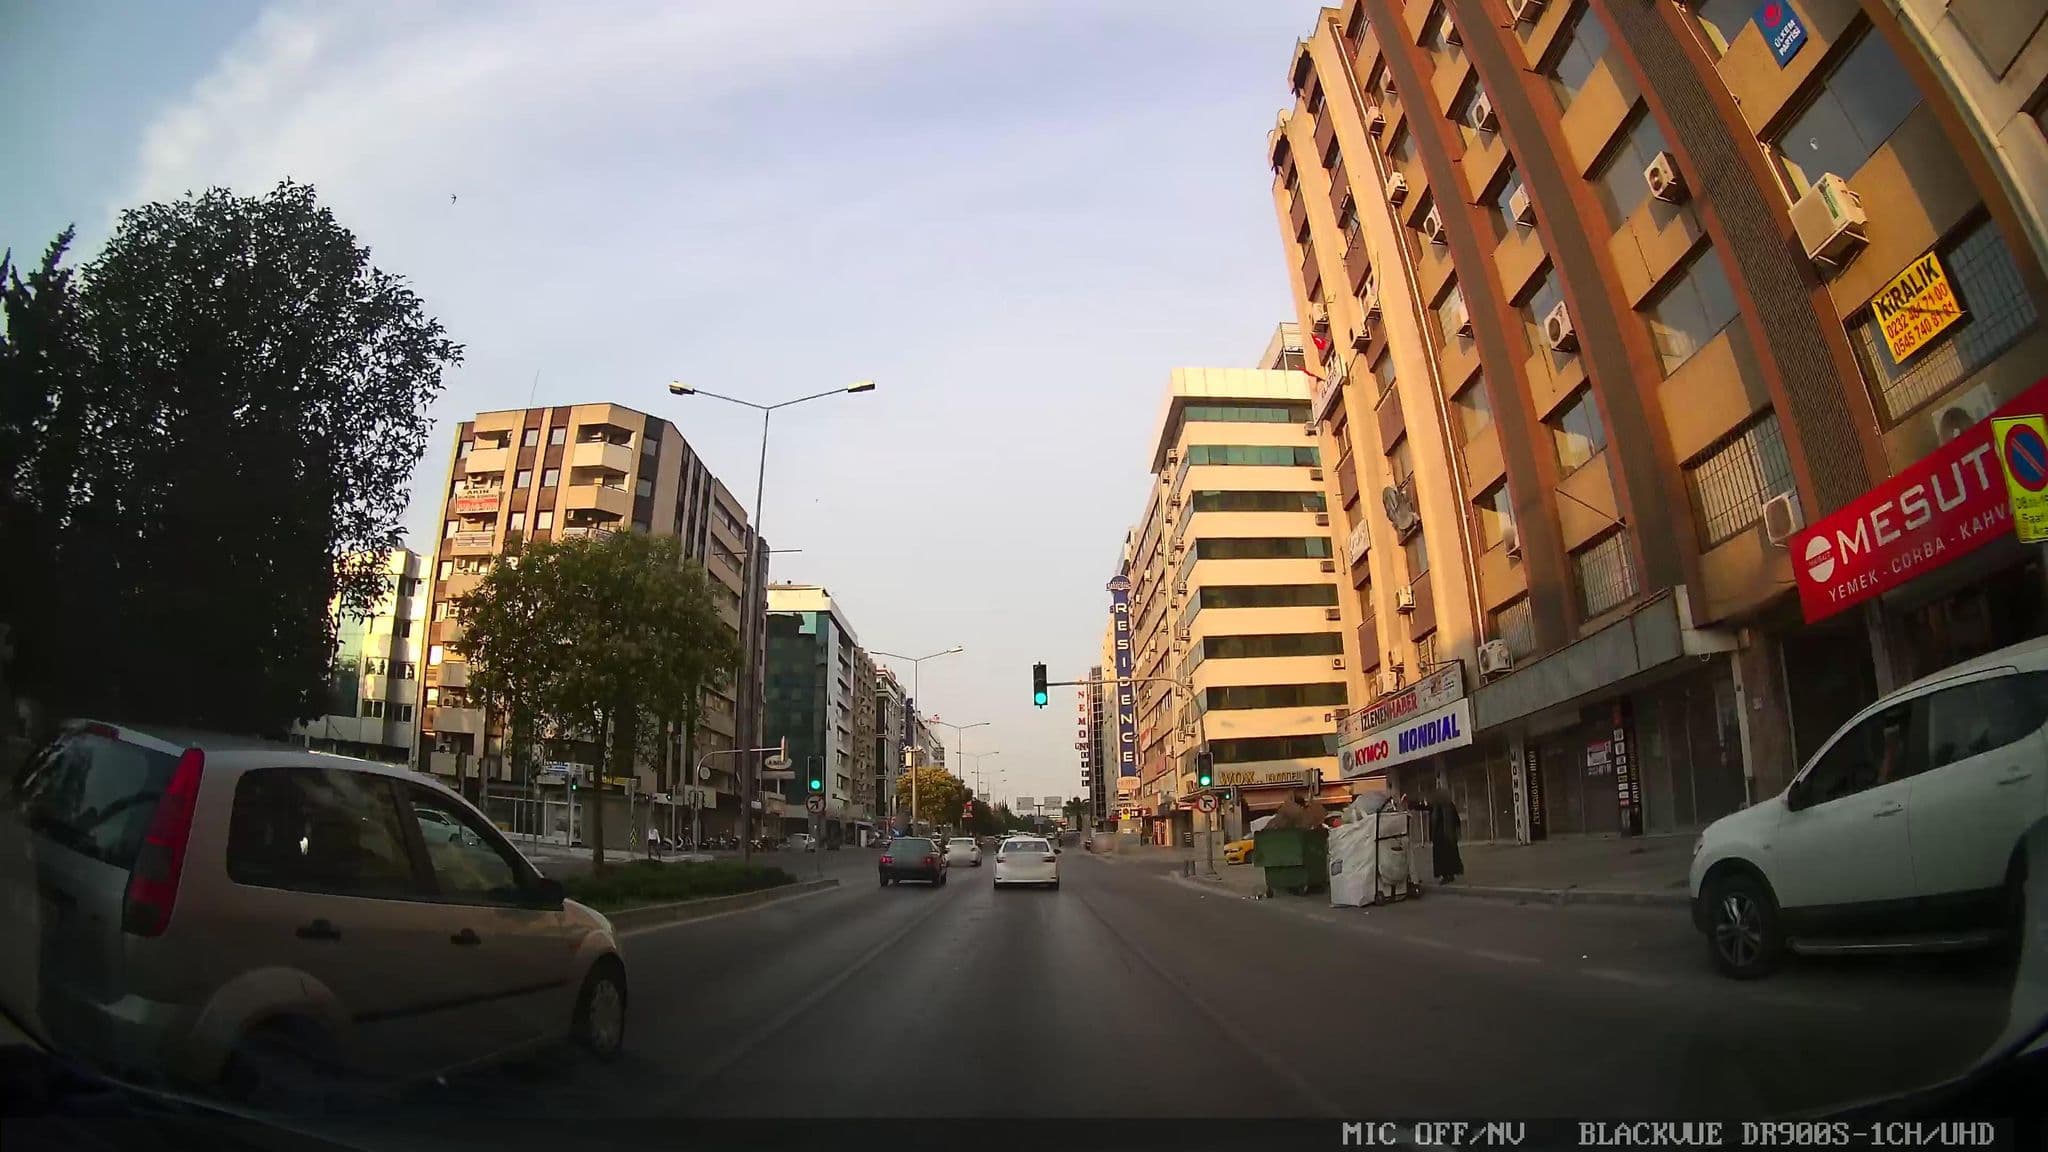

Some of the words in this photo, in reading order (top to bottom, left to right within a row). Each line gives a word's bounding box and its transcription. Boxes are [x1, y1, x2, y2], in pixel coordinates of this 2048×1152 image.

[1886, 314, 1909, 339] 0232
[1934, 282, 1948, 301] 00
[1893, 331, 1916, 356] 0545
[1914, 318, 1932, 339] 740
[1836, 442, 1990, 565] MESUT
[1828, 569, 1879, 602] YEMEK
[1959, 497, 2013, 540] KAHV
[1115, 602, 1135, 762] RESIDENCE
[1354, 740, 1389, 767] KYMCO
[1398, 713, 1461, 755] MONDIAL
